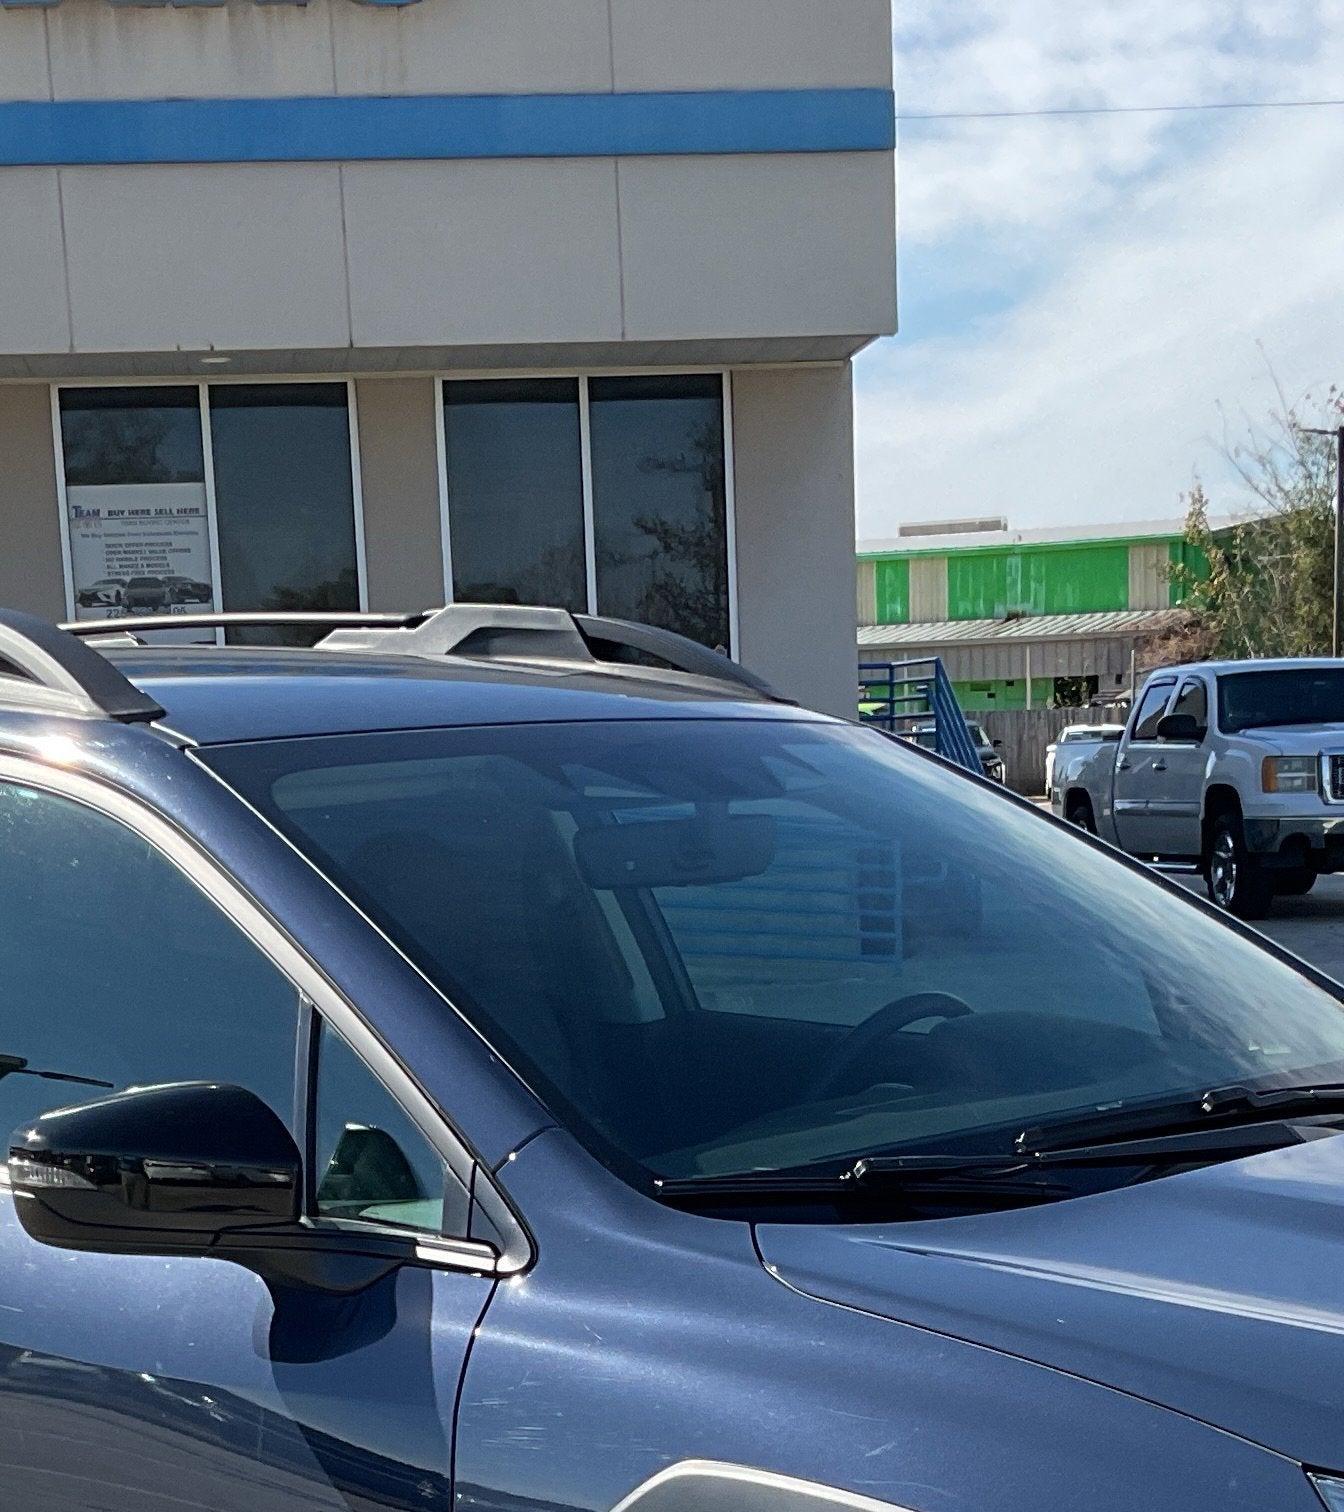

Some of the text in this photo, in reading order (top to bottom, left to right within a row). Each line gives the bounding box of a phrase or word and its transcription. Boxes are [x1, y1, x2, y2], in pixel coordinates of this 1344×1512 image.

[72, 505, 101, 518] TEAM
[108, 509, 126, 517] BUY
[128, 508, 152, 516] HERE
[154, 507, 174, 515] SELL
